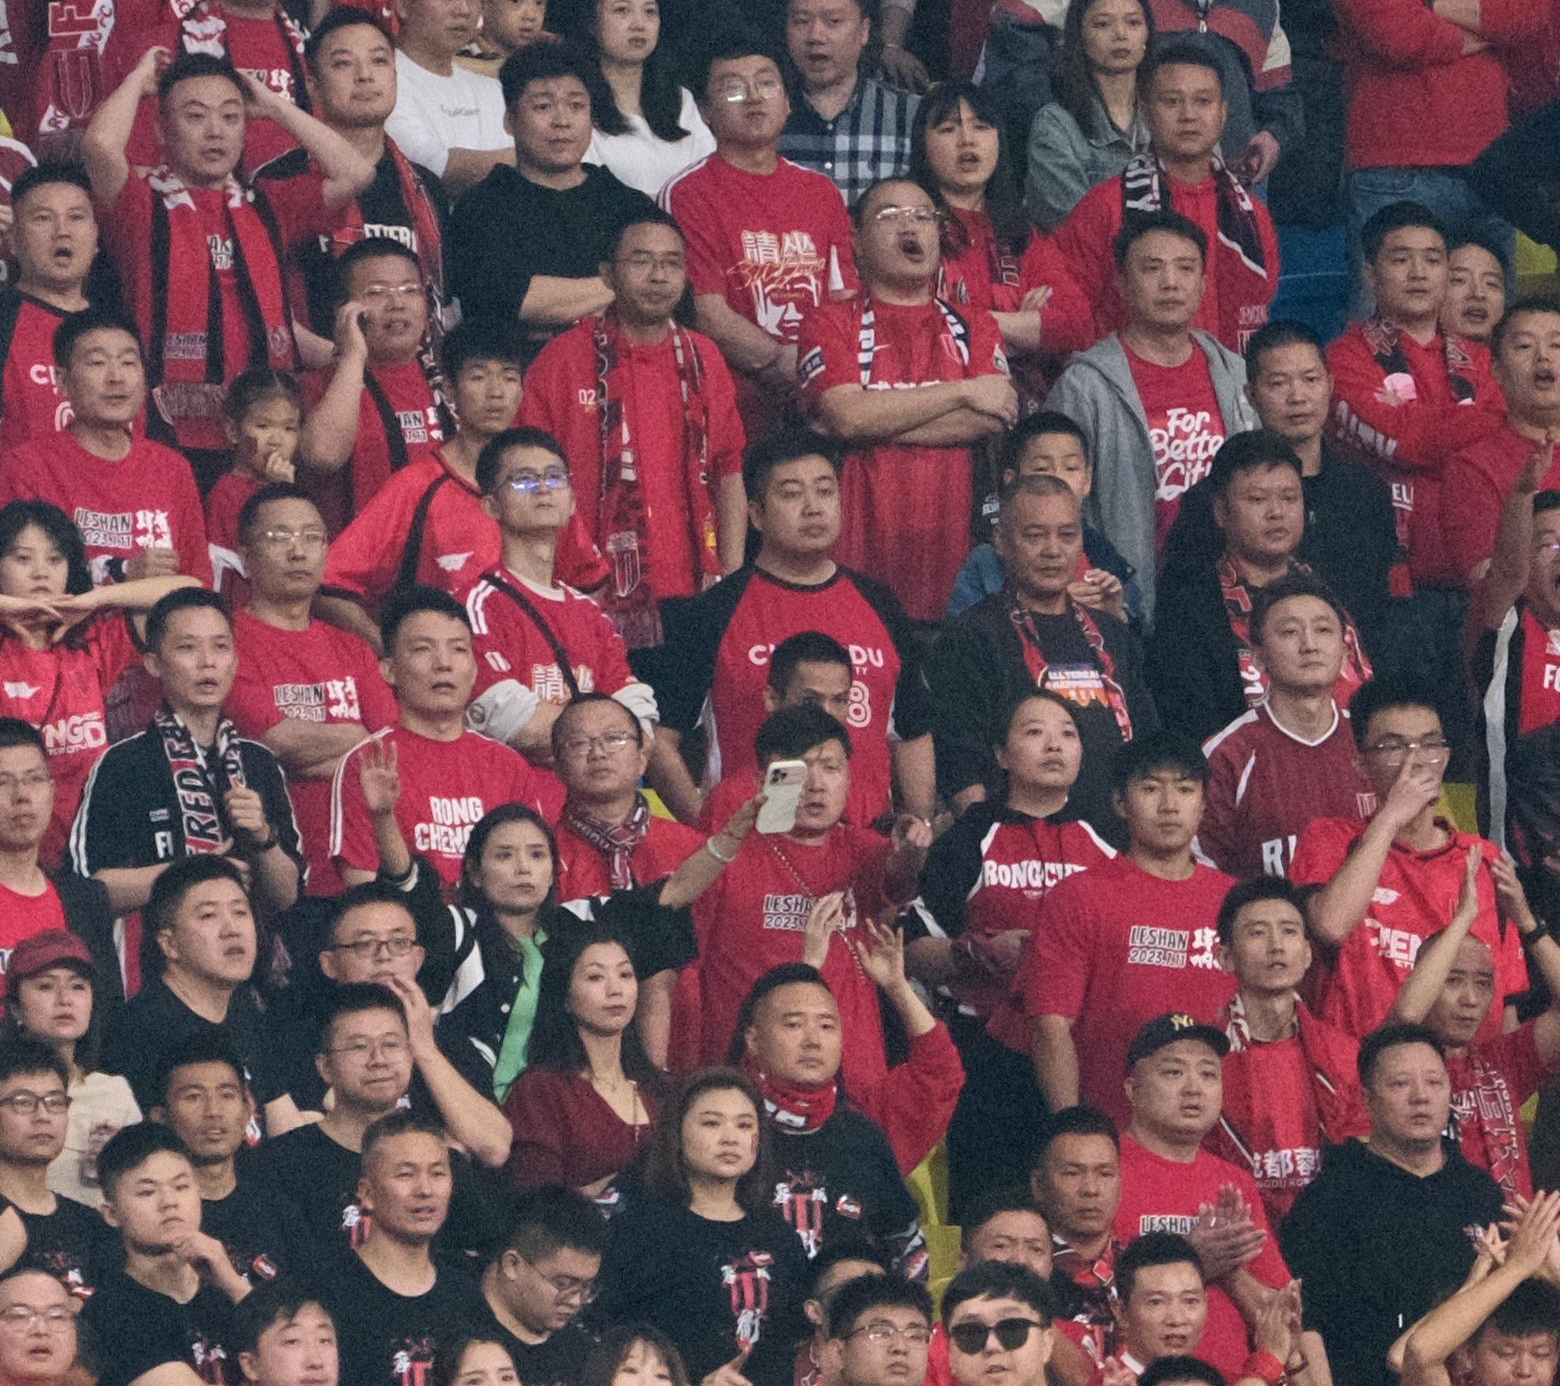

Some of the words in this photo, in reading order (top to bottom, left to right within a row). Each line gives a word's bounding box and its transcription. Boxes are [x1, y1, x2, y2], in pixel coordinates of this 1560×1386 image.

[1166, 409, 1210, 435] For
[75, 509, 130, 531] LESHAN
[275, 685, 324, 706] LESHAN
[428, 799, 485, 823] RONG
[1130, 926, 1188, 948] LESHAN
